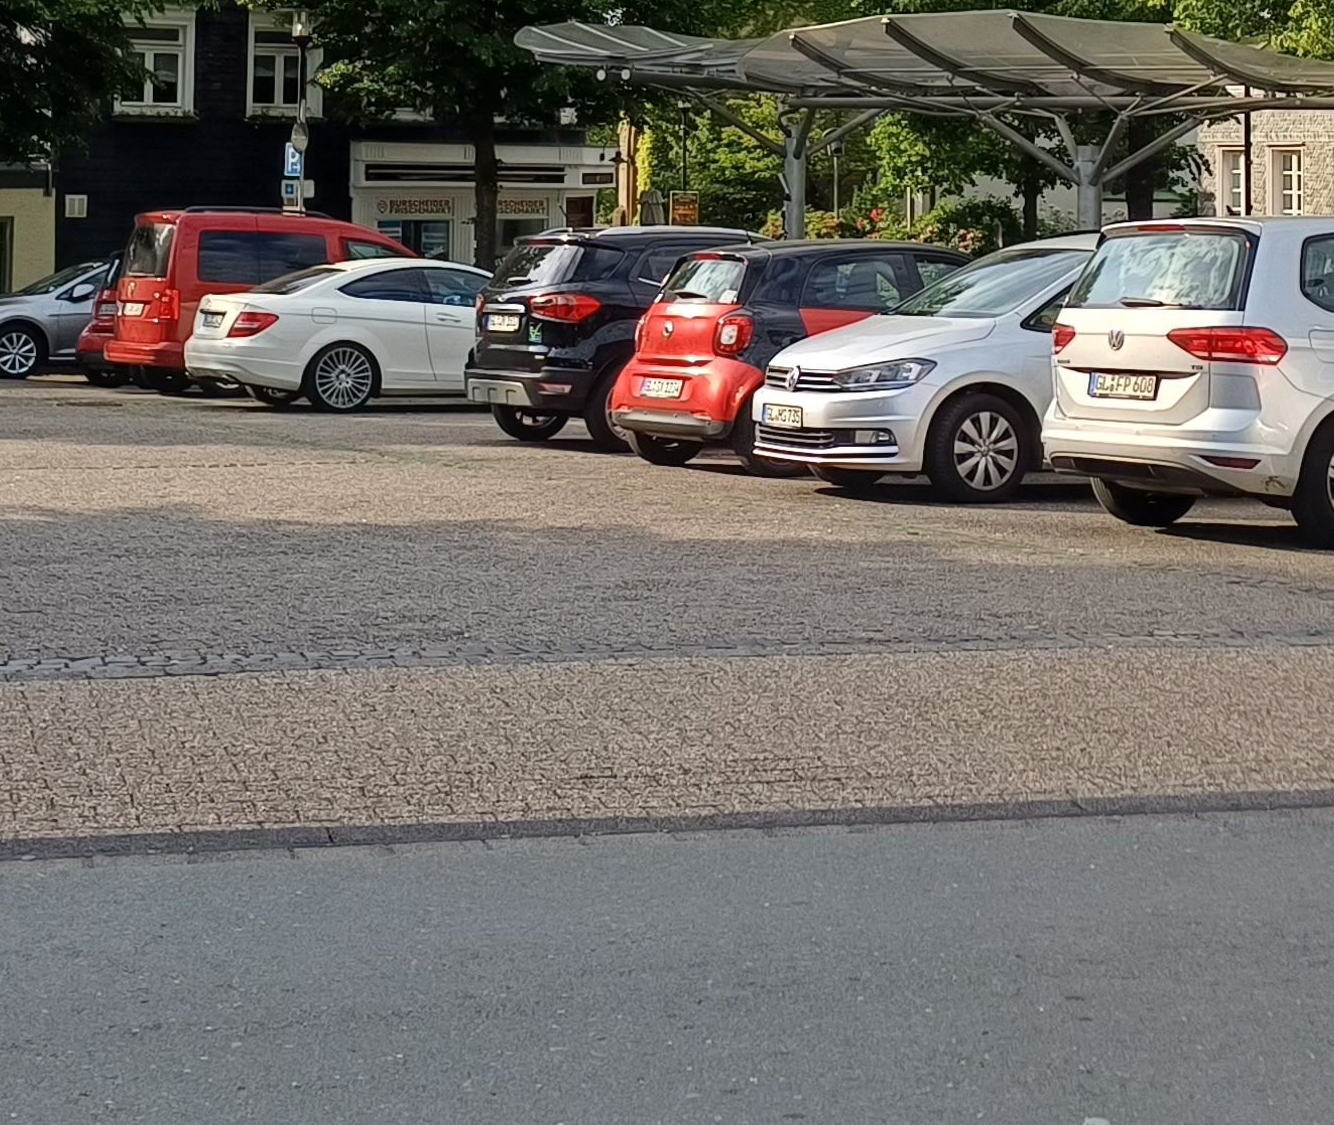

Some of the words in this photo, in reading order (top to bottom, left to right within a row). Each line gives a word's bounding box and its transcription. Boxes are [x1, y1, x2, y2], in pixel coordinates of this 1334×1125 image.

[389, 199, 451, 208] BURSCHEIDER
[498, 199, 545, 208] RSCHEIDER
[389, 207, 452, 215] FRISCHMARKT
[498, 207, 547, 215] SCHMARKT
[1095, 375, 1110, 392] GL
[1115, 376, 1132, 392] FP
[1132, 377, 1154, 394] 608
